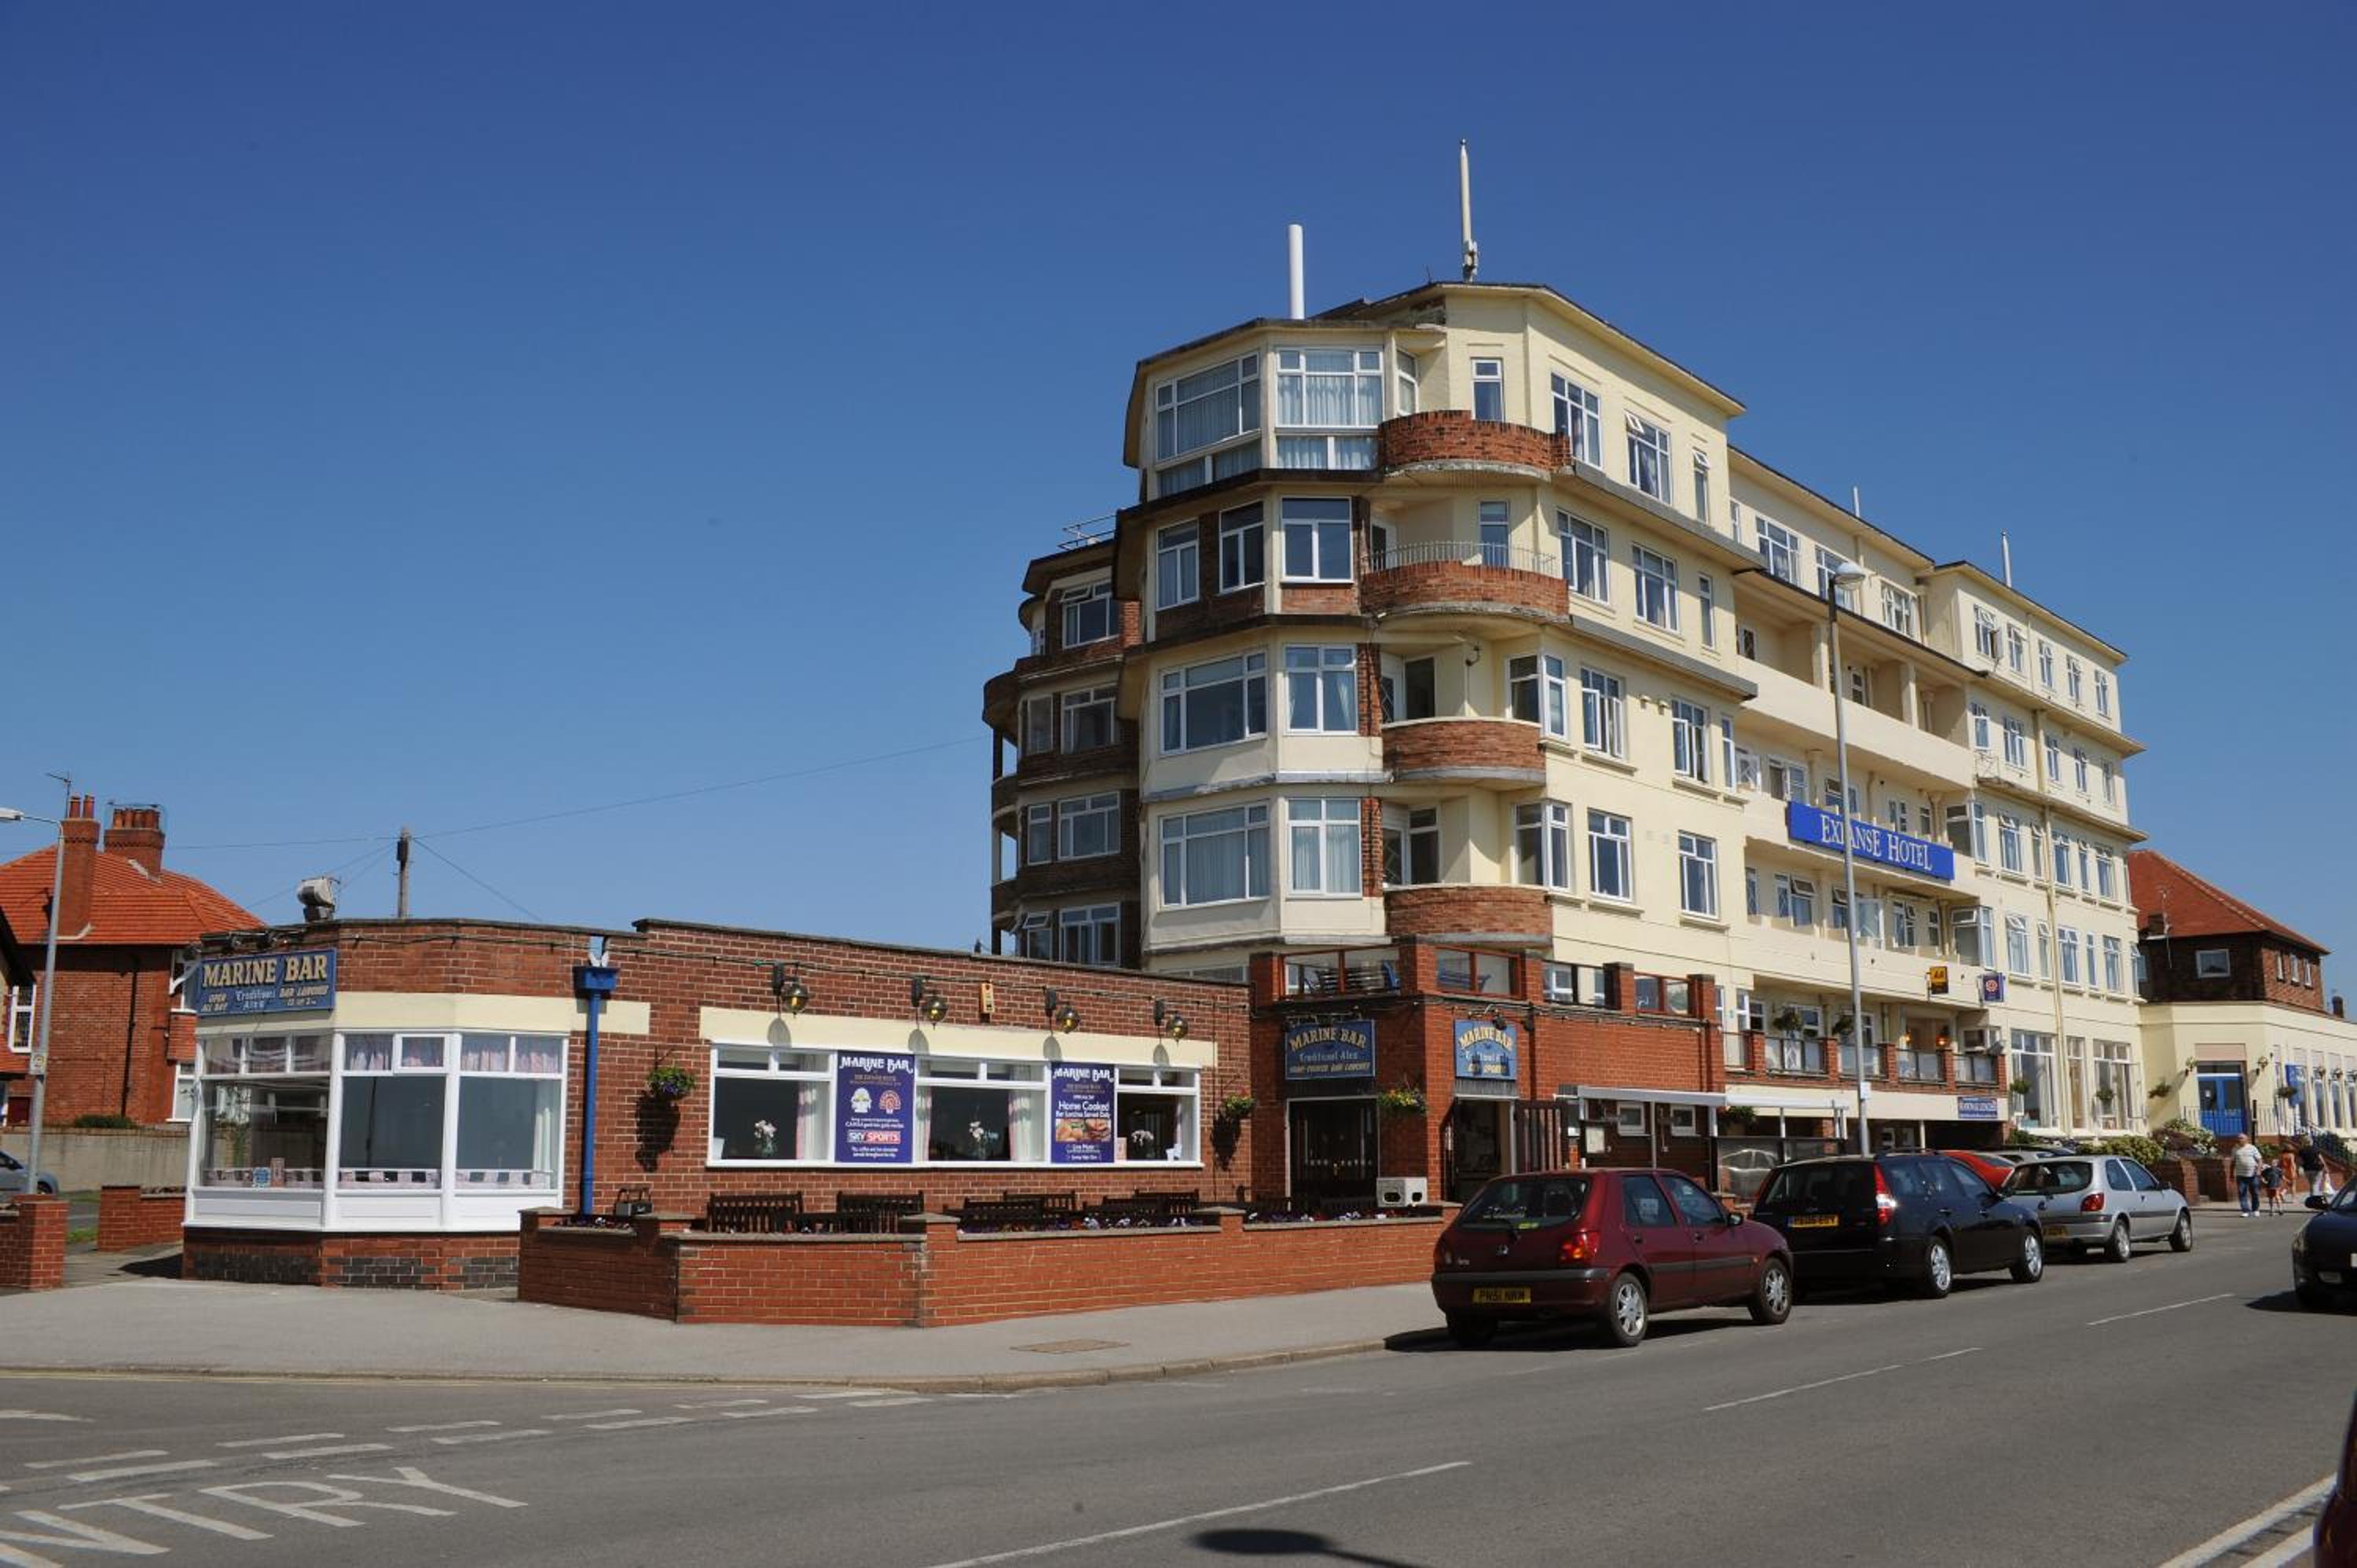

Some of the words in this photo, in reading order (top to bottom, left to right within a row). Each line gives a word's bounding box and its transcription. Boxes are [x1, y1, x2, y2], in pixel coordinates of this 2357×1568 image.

[1820, 815, 1882, 857] EXANSE
[1888, 833, 1933, 871] HOTEL
[202, 958, 277, 987] MARINE
[284, 954, 328, 982] BAR
[1289, 1026, 1336, 1052] MARINE
[1340, 1028, 1366, 1050] BAR
[1458, 1026, 1495, 1050] MARINE
[1495, 1028, 1512, 1052] BAR
[839, 1057, 885, 1072] MARINE
[887, 1059, 913, 1074] BAR
[1053, 1068, 1091, 1081] MARINE
[1092, 1069, 1114, 1083] BAR
[1058, 1101, 1081, 1110] Home
[1082, 1101, 1109, 1112] Cooked
[866, 1133, 899, 1142] SPORTS
